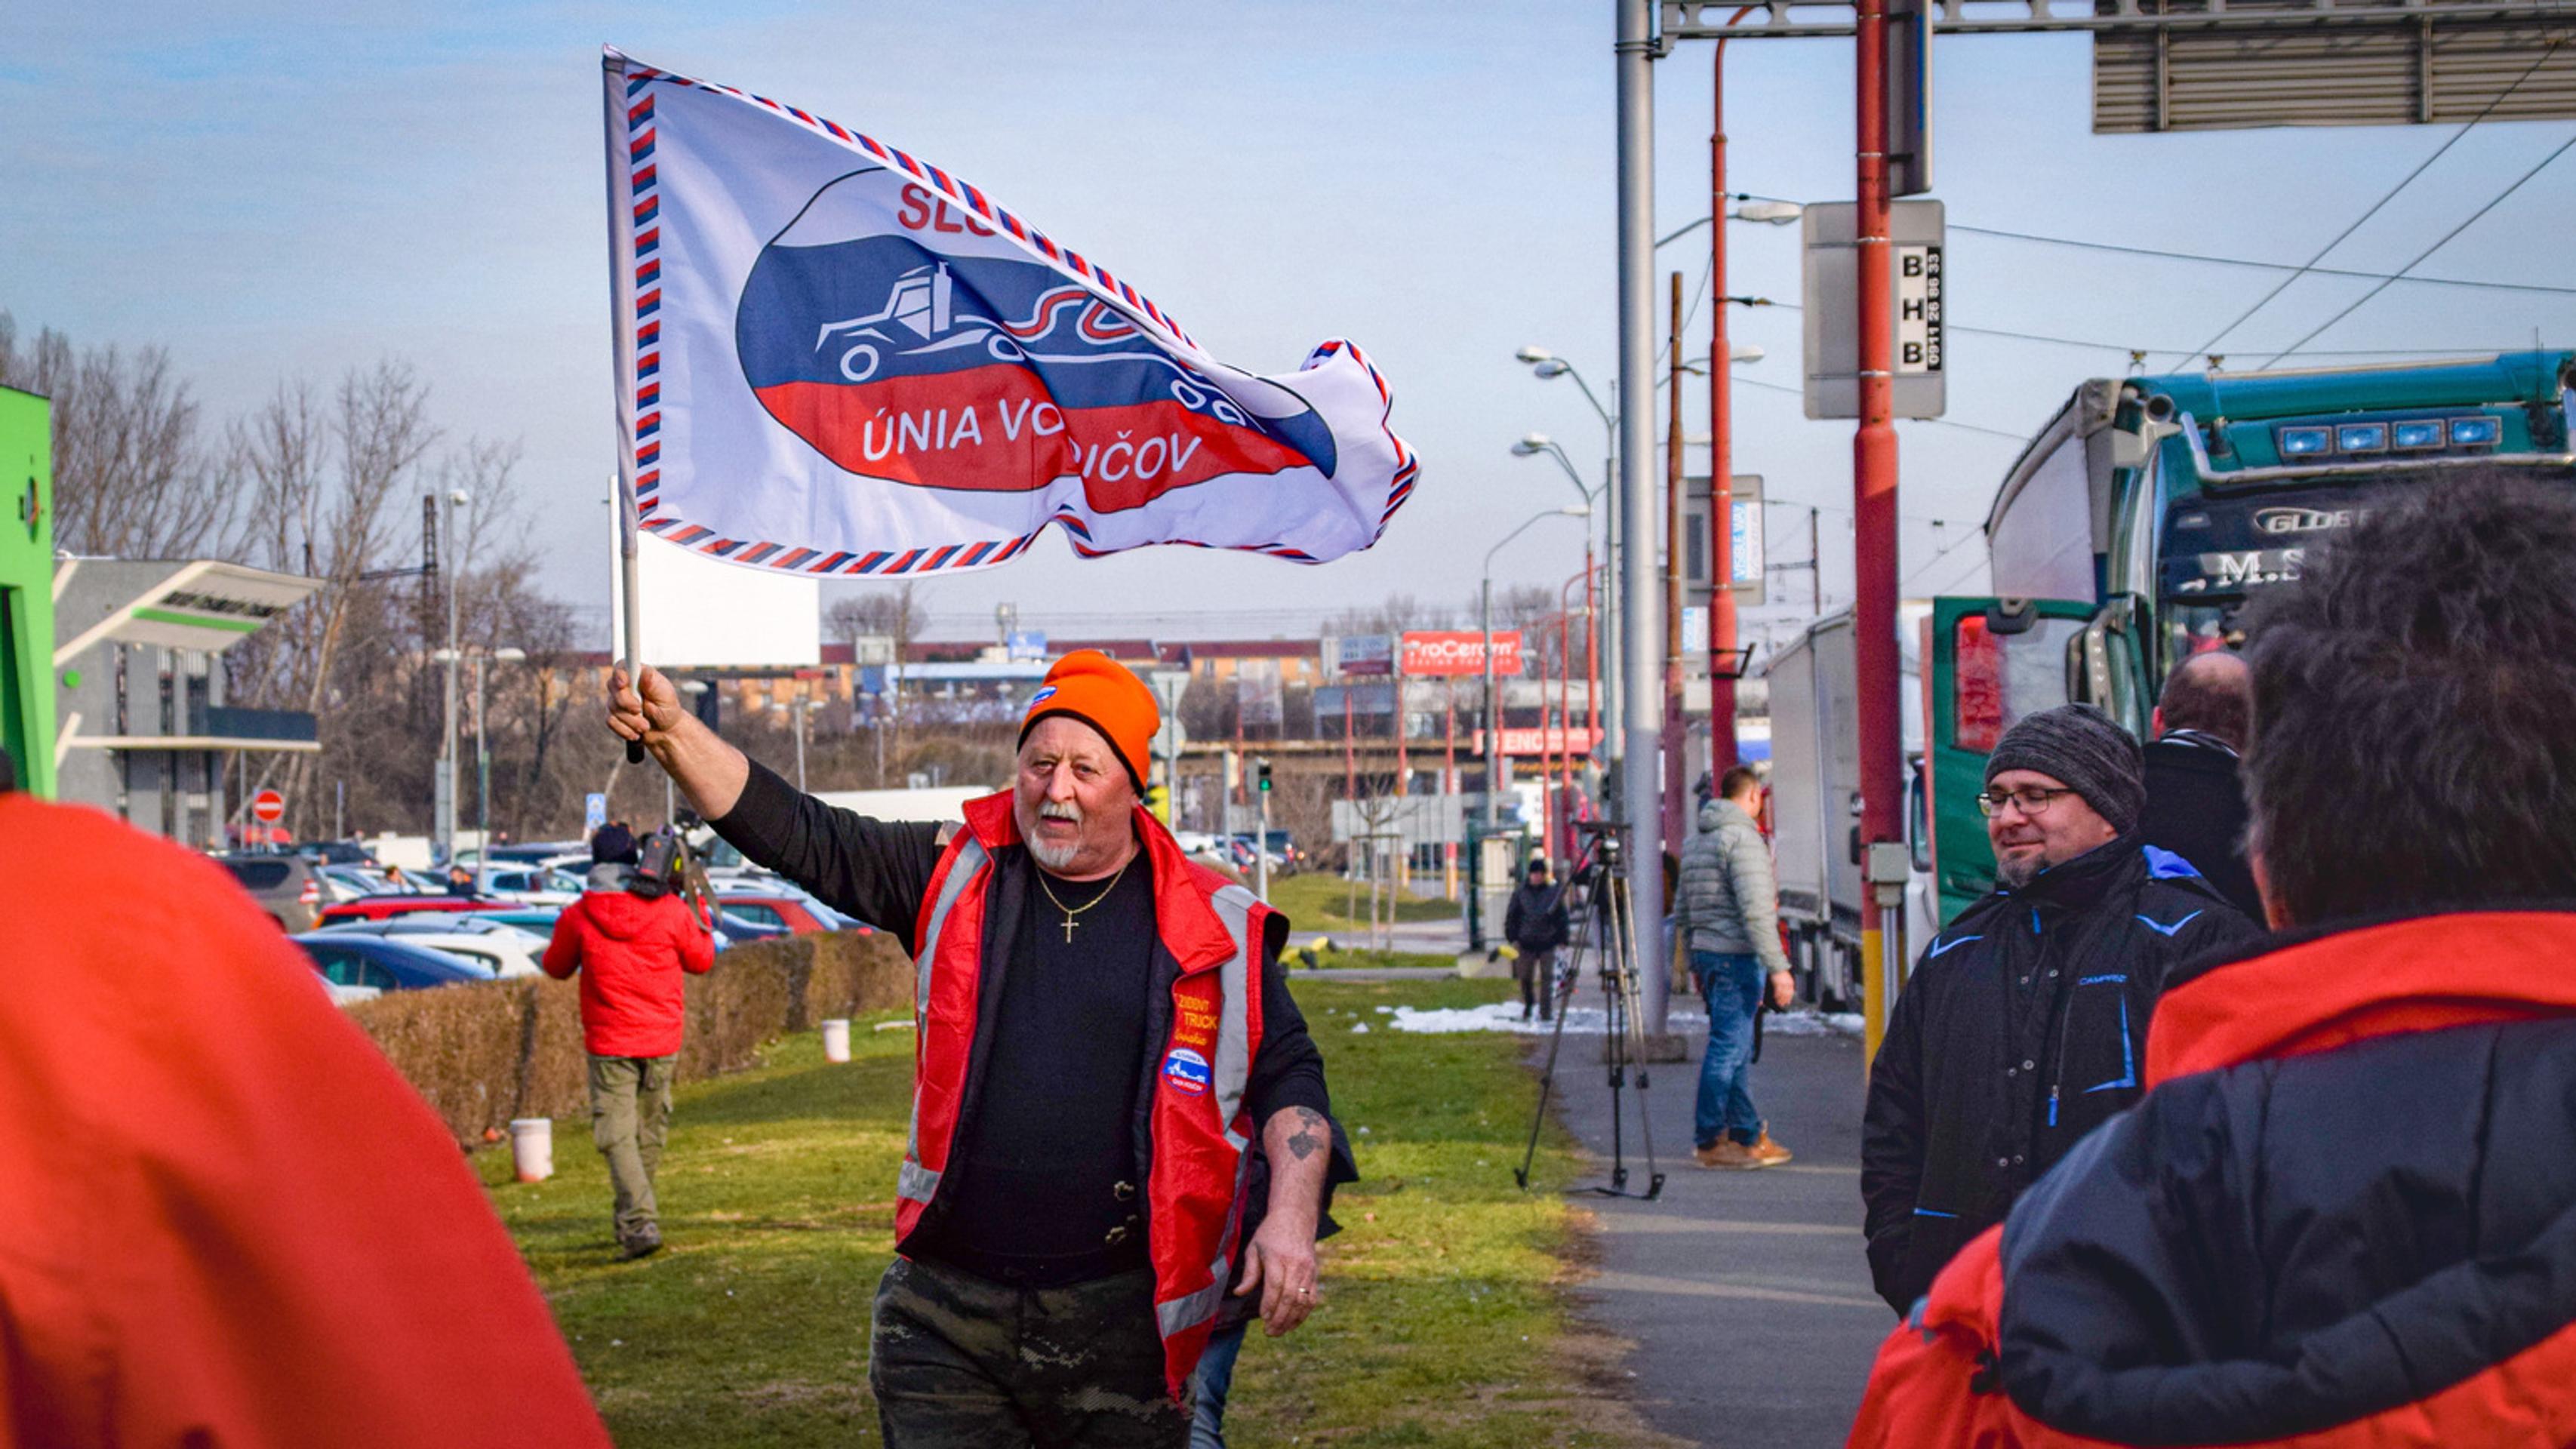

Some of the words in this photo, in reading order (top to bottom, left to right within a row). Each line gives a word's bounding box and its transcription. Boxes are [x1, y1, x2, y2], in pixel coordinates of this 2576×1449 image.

[1928, 253, 1940, 273] 33
[1928, 301, 1940, 321] 26
[1928, 326, 1940, 366] 0911
[863, 405, 983, 462] ÚNIA
[1183, 1012, 1218, 1030] TRUCK
